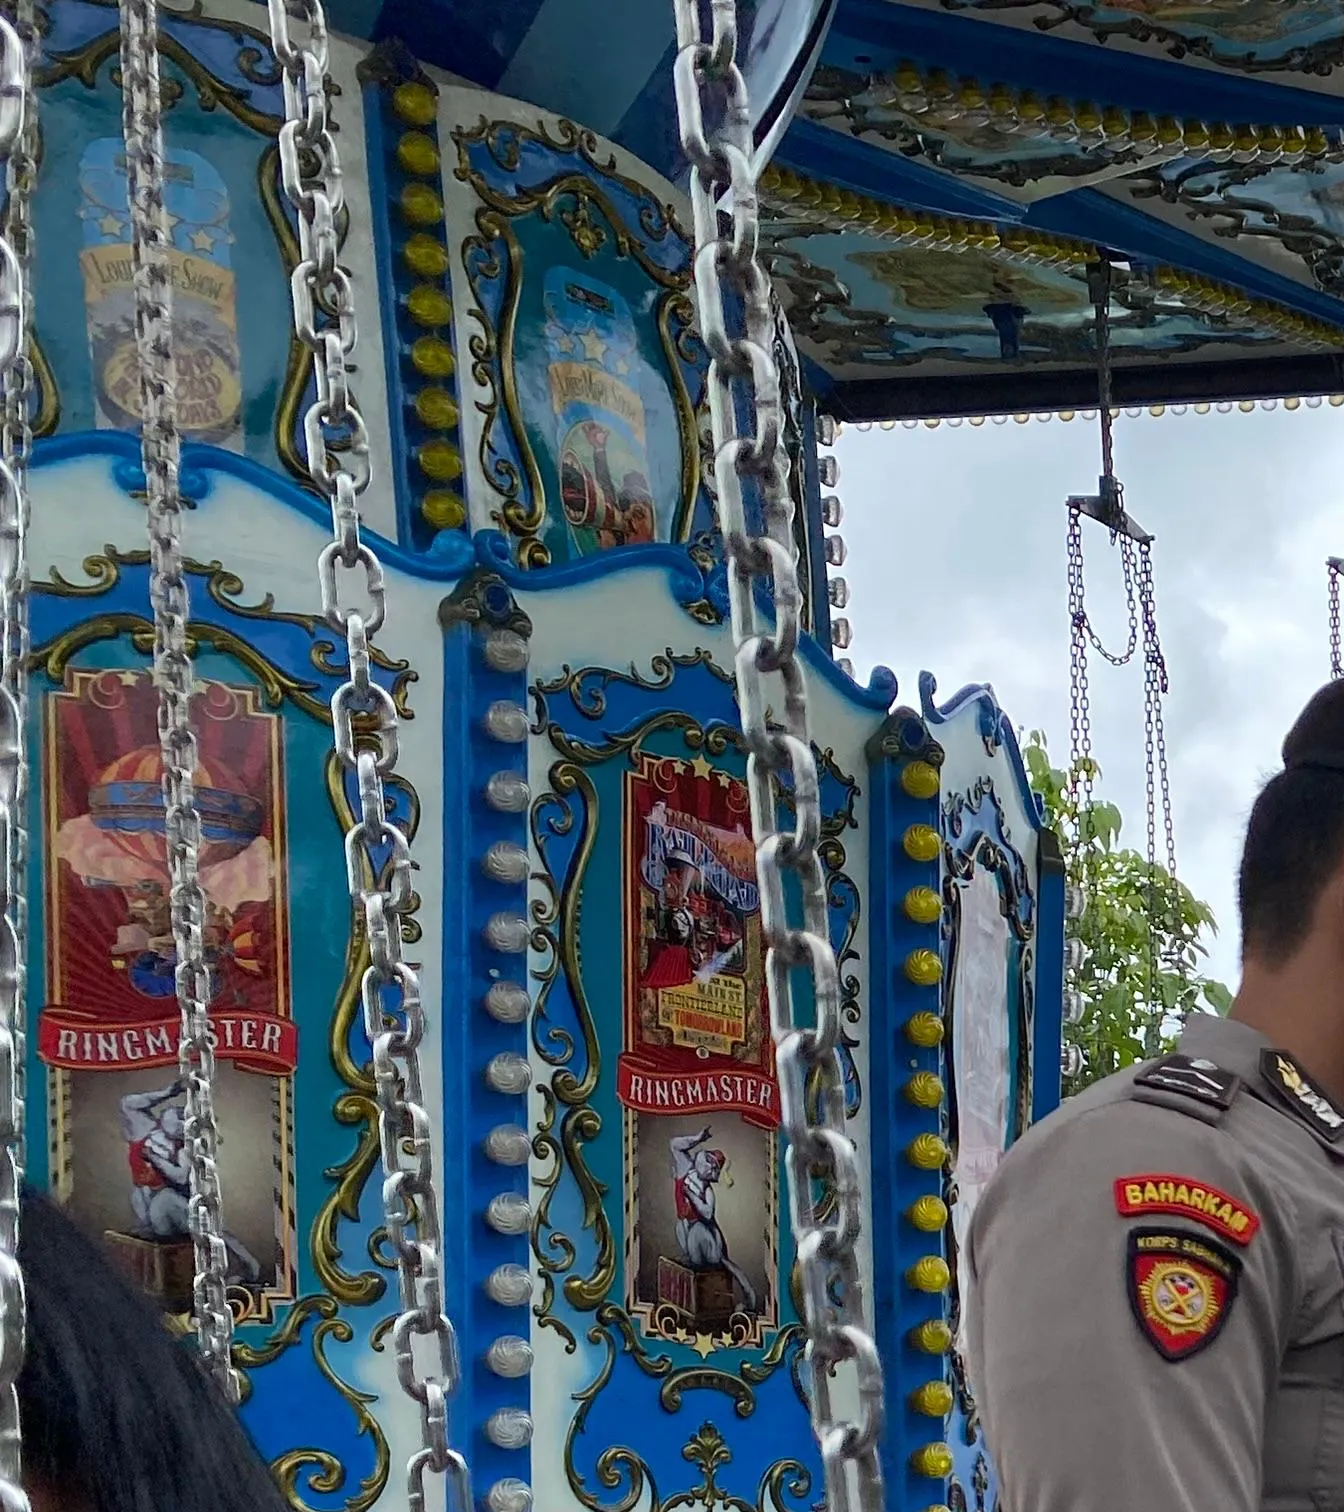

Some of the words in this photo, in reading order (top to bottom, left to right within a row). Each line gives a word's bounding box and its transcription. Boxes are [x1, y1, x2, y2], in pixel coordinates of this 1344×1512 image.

[56, 1020, 282, 1062] RINGMSTER
[629, 1074, 772, 1109] RINGMASTER
[1125, 1181, 1249, 1232] BAHARKAM
